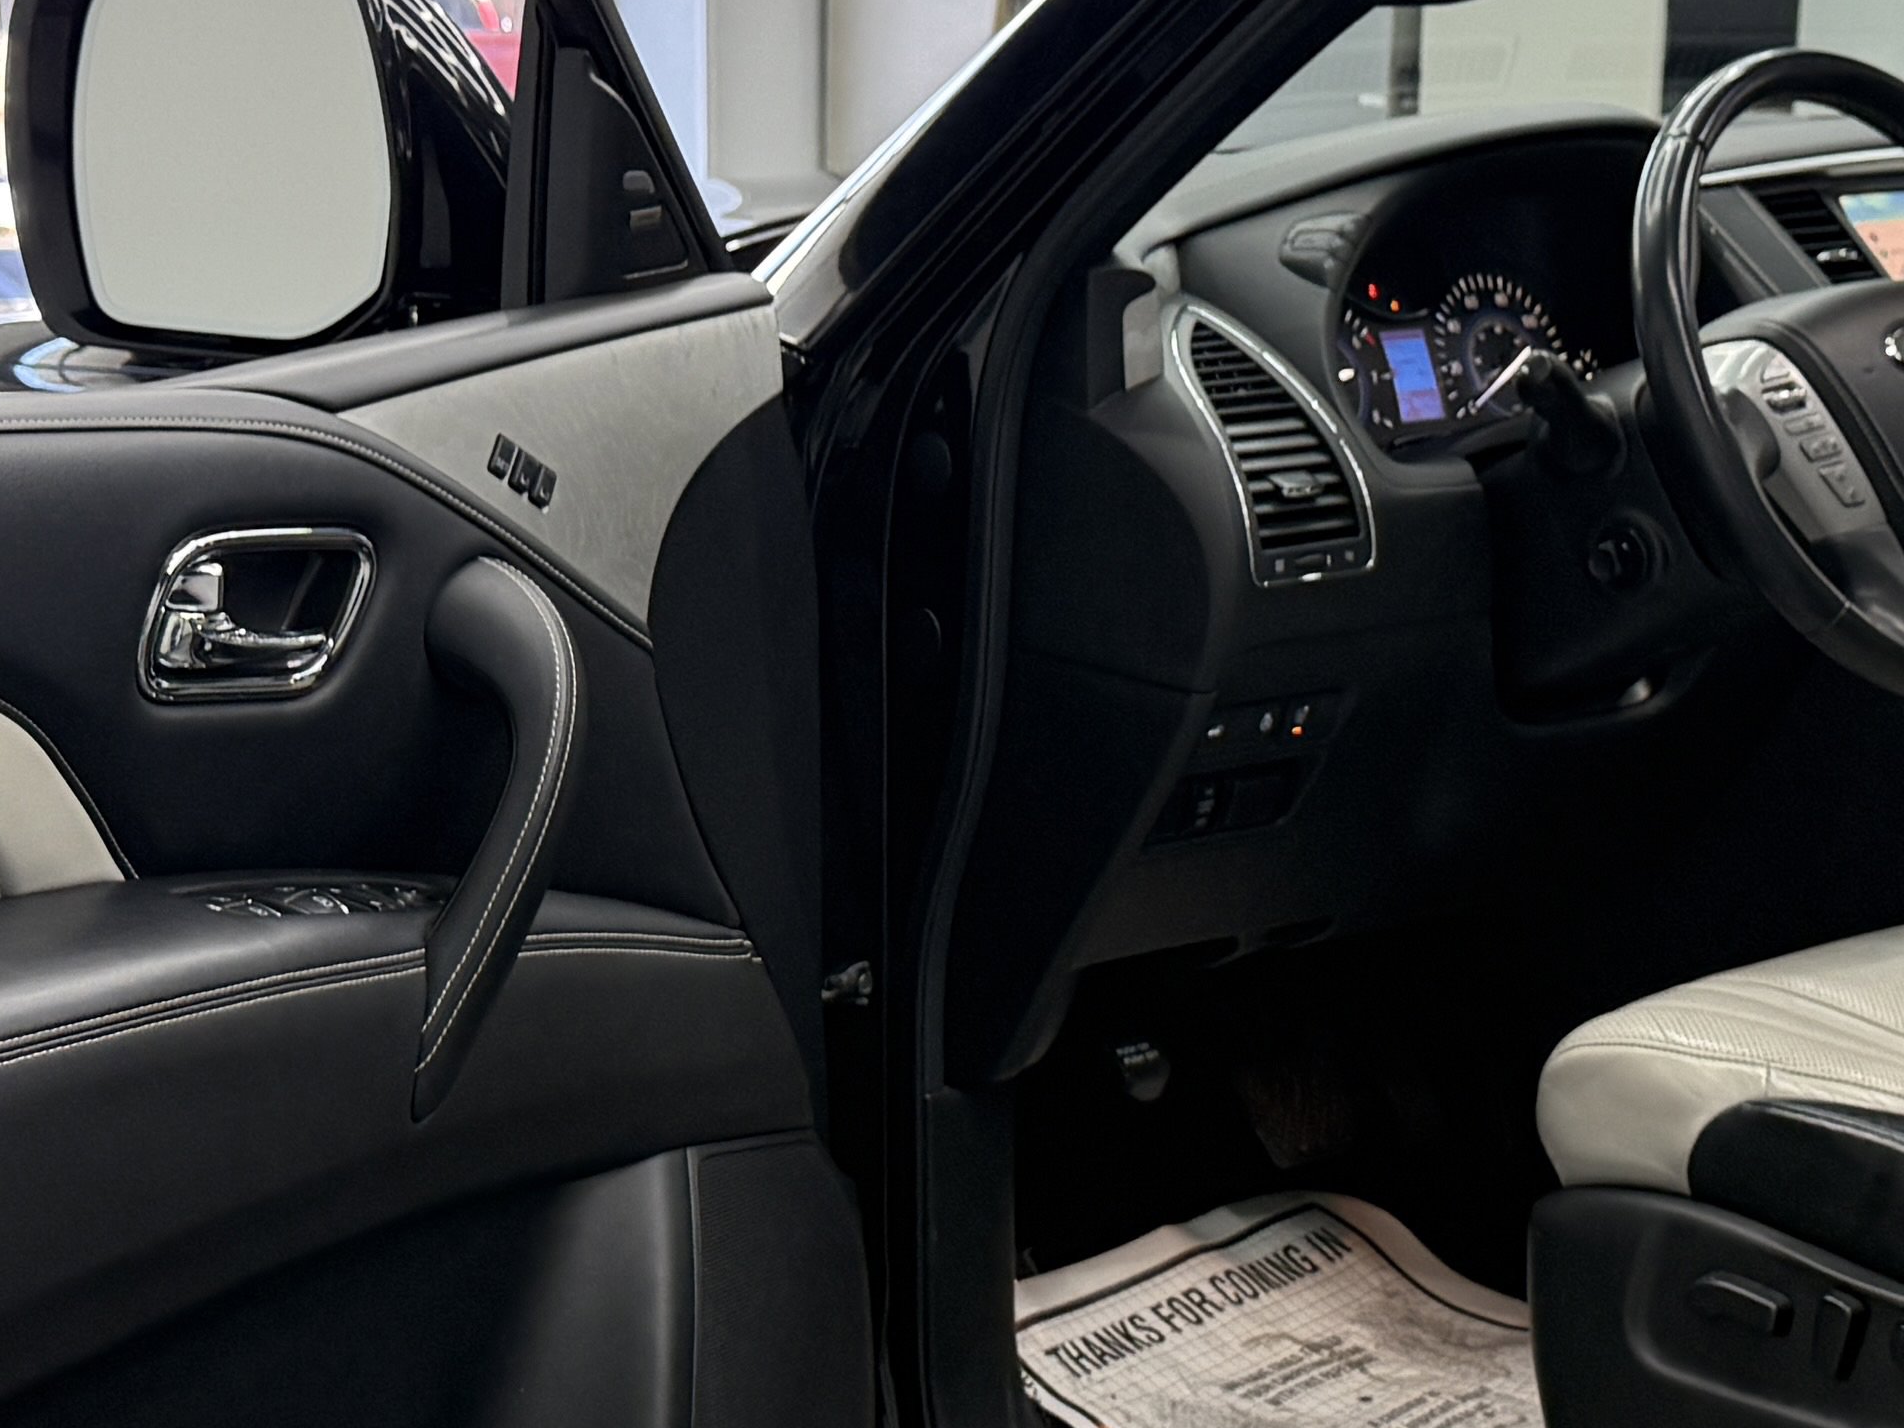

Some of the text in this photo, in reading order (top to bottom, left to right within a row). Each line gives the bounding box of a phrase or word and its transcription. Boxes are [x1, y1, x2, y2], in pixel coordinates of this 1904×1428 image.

[1044, 1314, 1166, 1379] THANKS
[1151, 1288, 1222, 1335] FOR
[1208, 1243, 1320, 1307] COMING
[1306, 1227, 1353, 1264] IN
